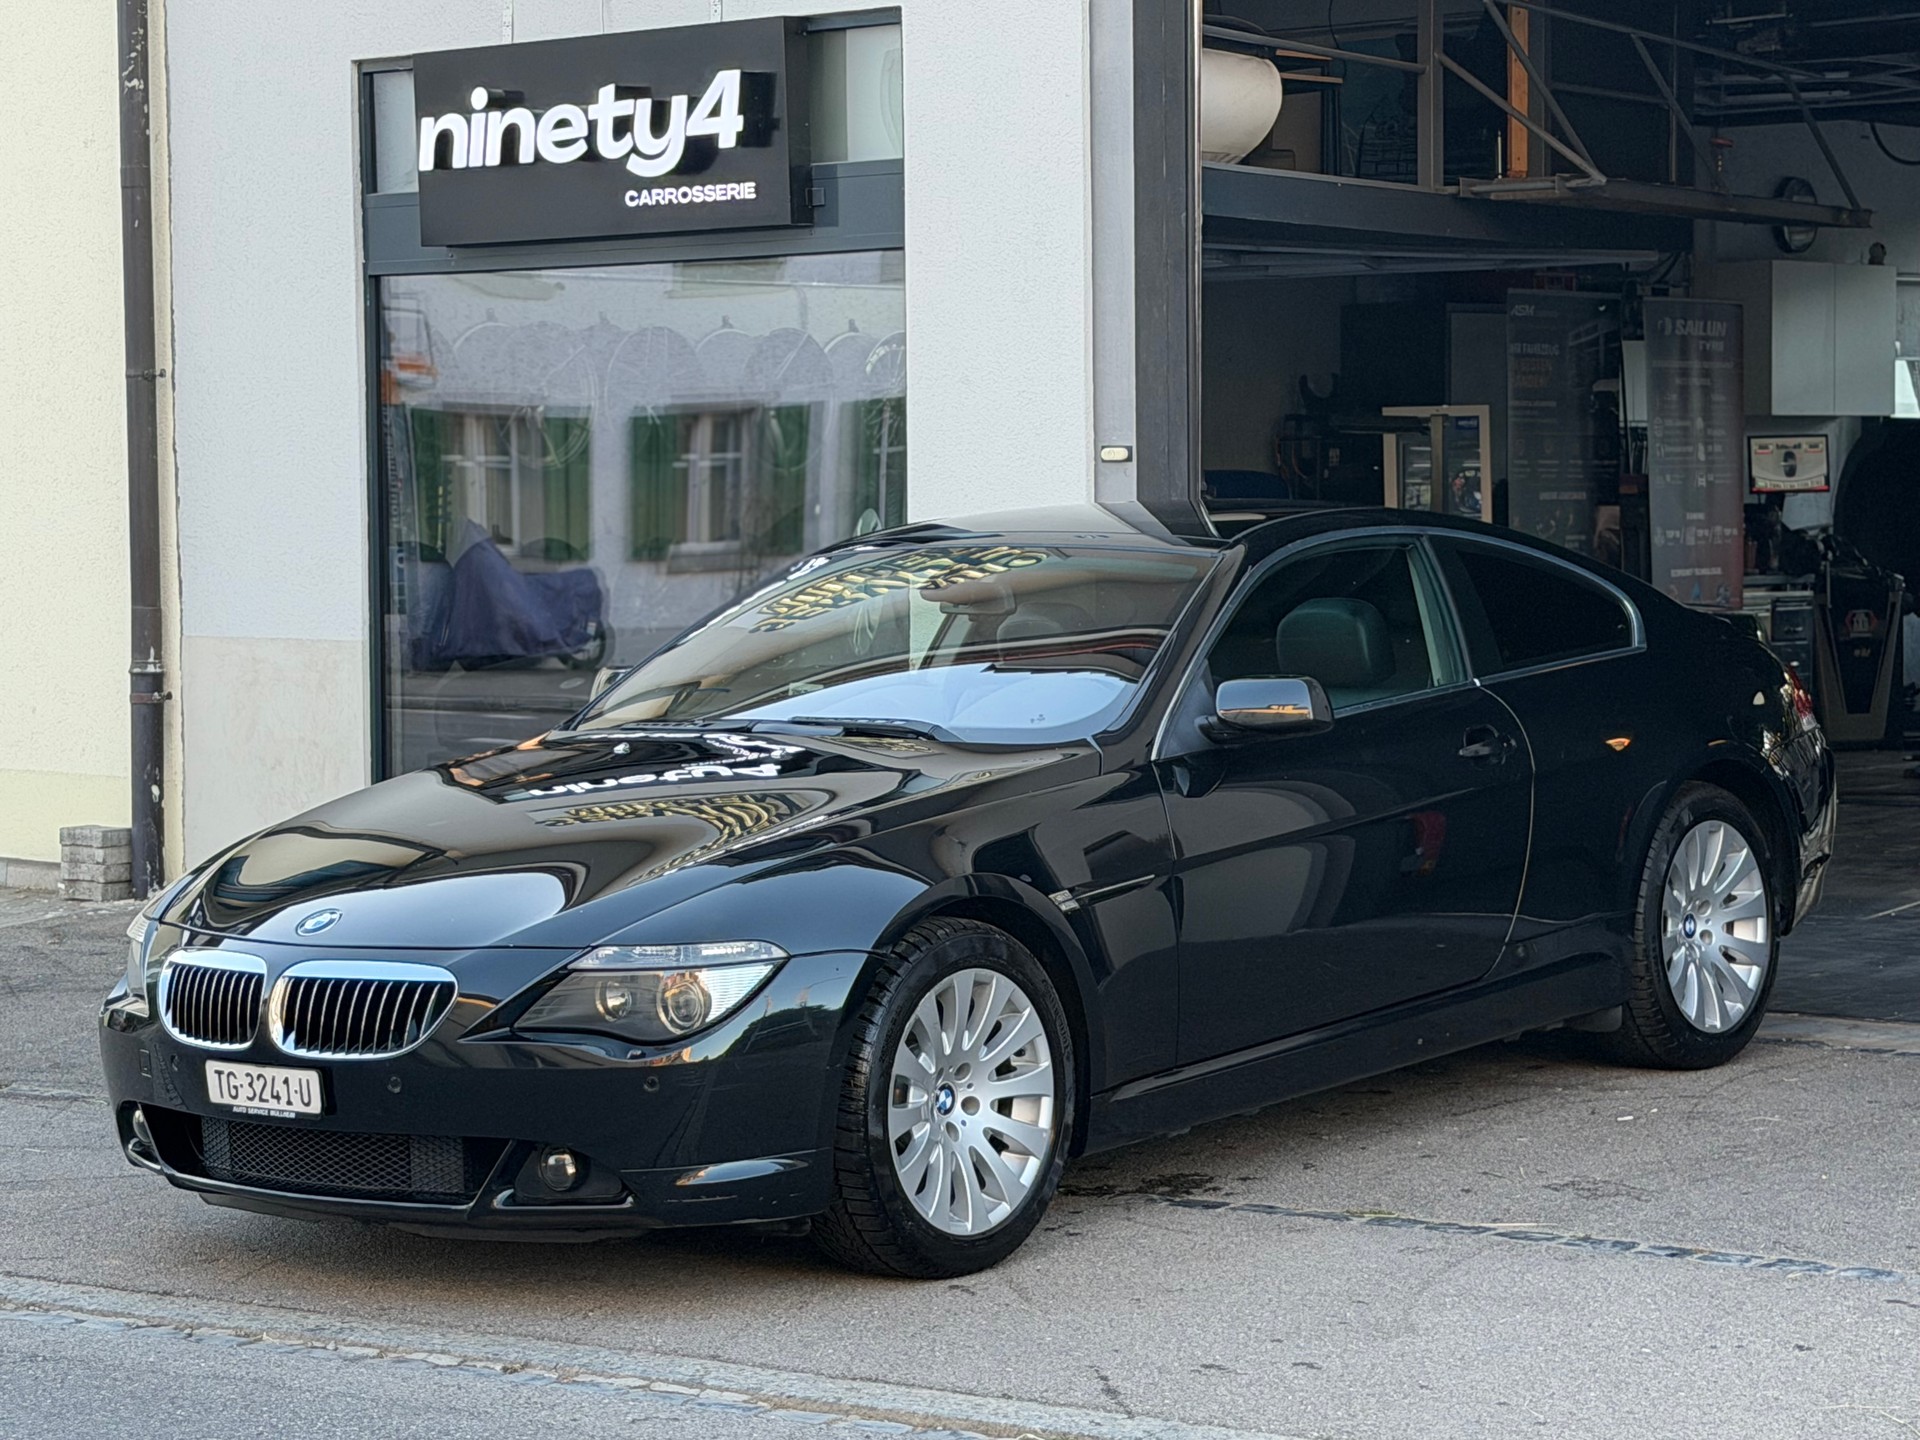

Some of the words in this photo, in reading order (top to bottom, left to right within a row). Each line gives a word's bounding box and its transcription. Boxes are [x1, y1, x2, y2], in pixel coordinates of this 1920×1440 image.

[418, 69, 744, 178] ninety4
[624, 181, 757, 208] CARROSSERIE
[1674, 318, 1727, 337] SAILUN
[232, 1105, 247, 1114] AUTO
[247, 1107, 269, 1116] SERVICE
